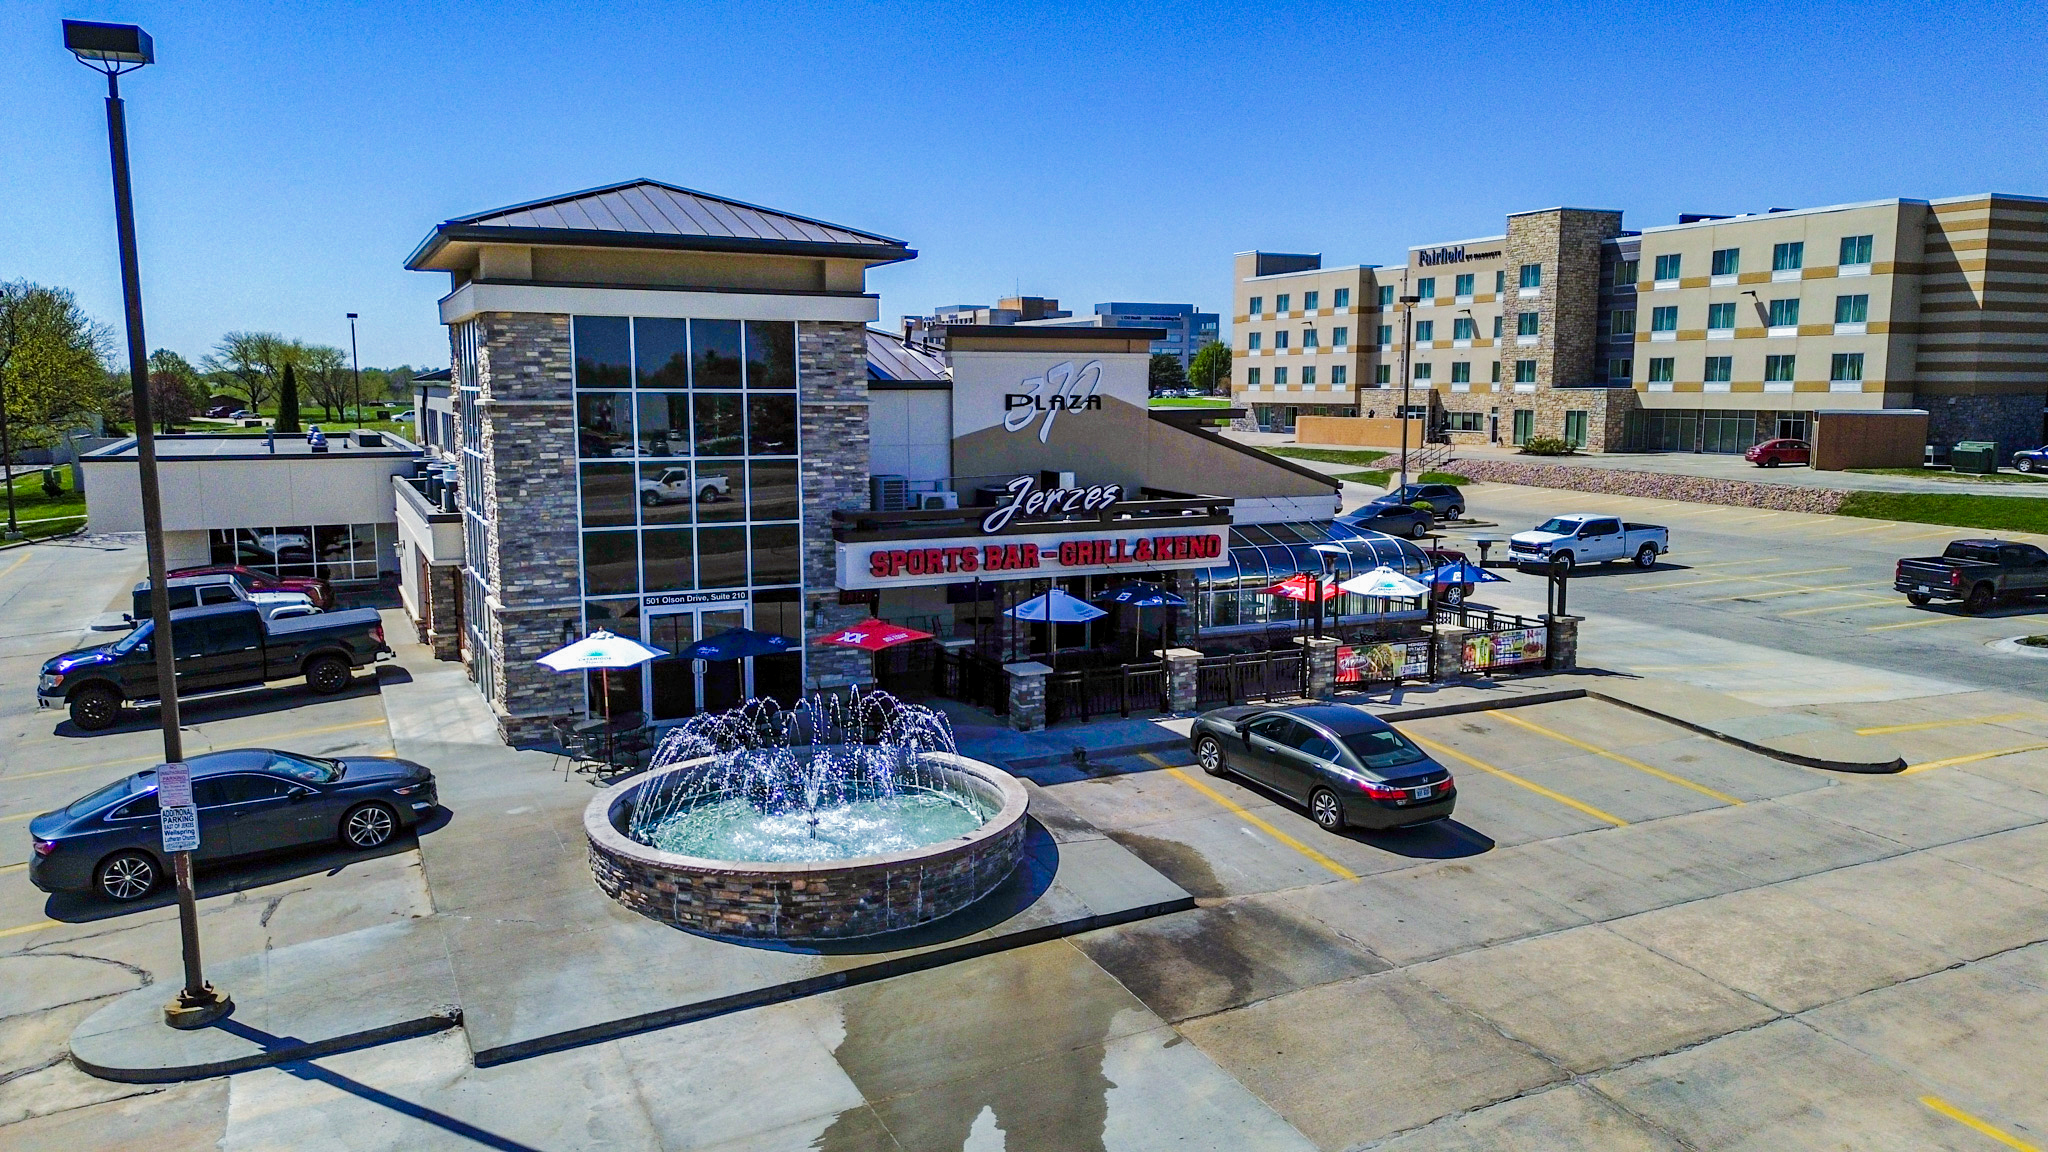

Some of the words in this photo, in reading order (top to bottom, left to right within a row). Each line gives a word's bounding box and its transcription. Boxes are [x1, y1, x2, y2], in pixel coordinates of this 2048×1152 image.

[1418, 246, 1465, 267] Fairfield
[1003, 360, 1103, 444] 370
[1005, 394, 1101, 411] PLAZA
[982, 475, 1120, 533] Jerzes
[870, 546, 980, 577] SPORTS
[982, 543, 1041, 571] BAR
[1059, 539, 1132, 566] GRILL
[1152, 534, 1222, 561] KENO
[646, 597, 660, 605] 501
[662, 596, 685, 604] Olson
[686, 594, 709, 603] Drive,
[710, 593, 730, 601] Suite
[731, 591, 746, 600] 210
[162, 808, 194, 817] ADDITIONAL
[162, 815, 194, 824] PARKING
